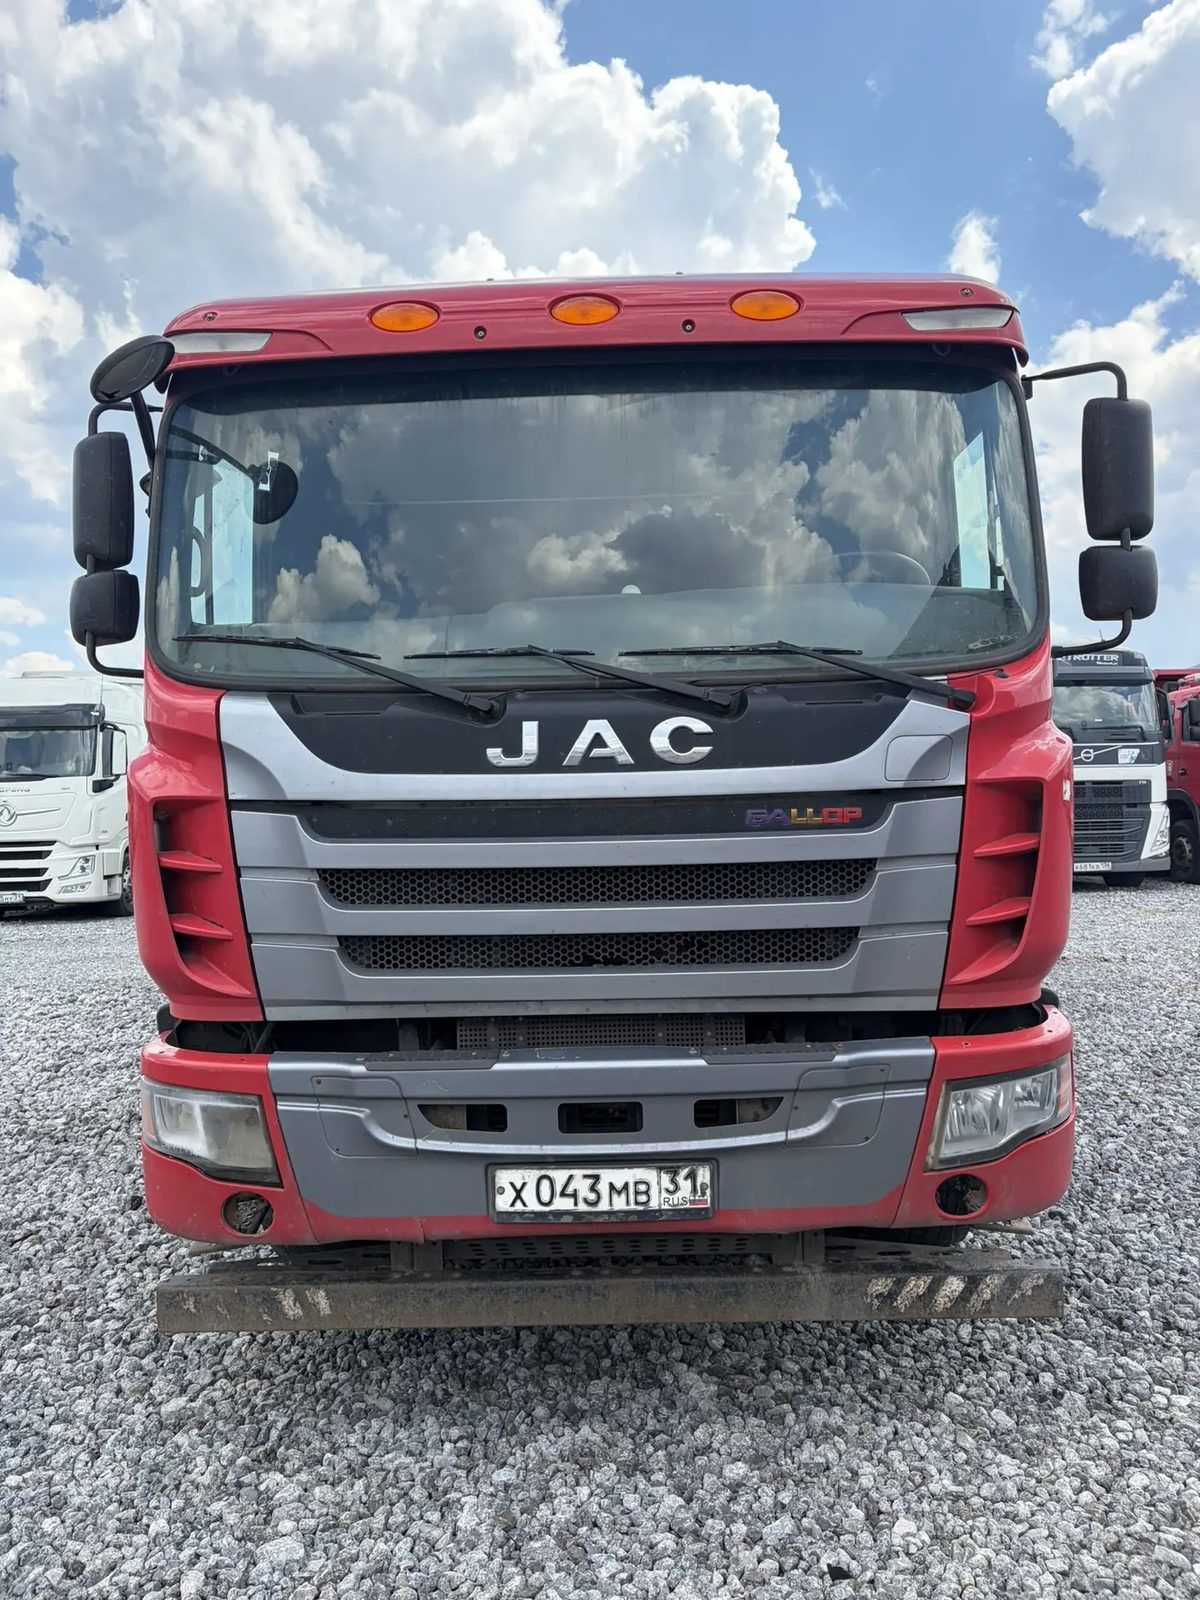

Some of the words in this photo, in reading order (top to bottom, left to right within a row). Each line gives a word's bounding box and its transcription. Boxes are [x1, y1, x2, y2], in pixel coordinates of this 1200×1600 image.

[486, 716, 714, 767] JAC
[745, 807, 862, 826] GALLOP
[663, 1167, 701, 1196] 31
[663, 1196, 689, 1207] RUS
